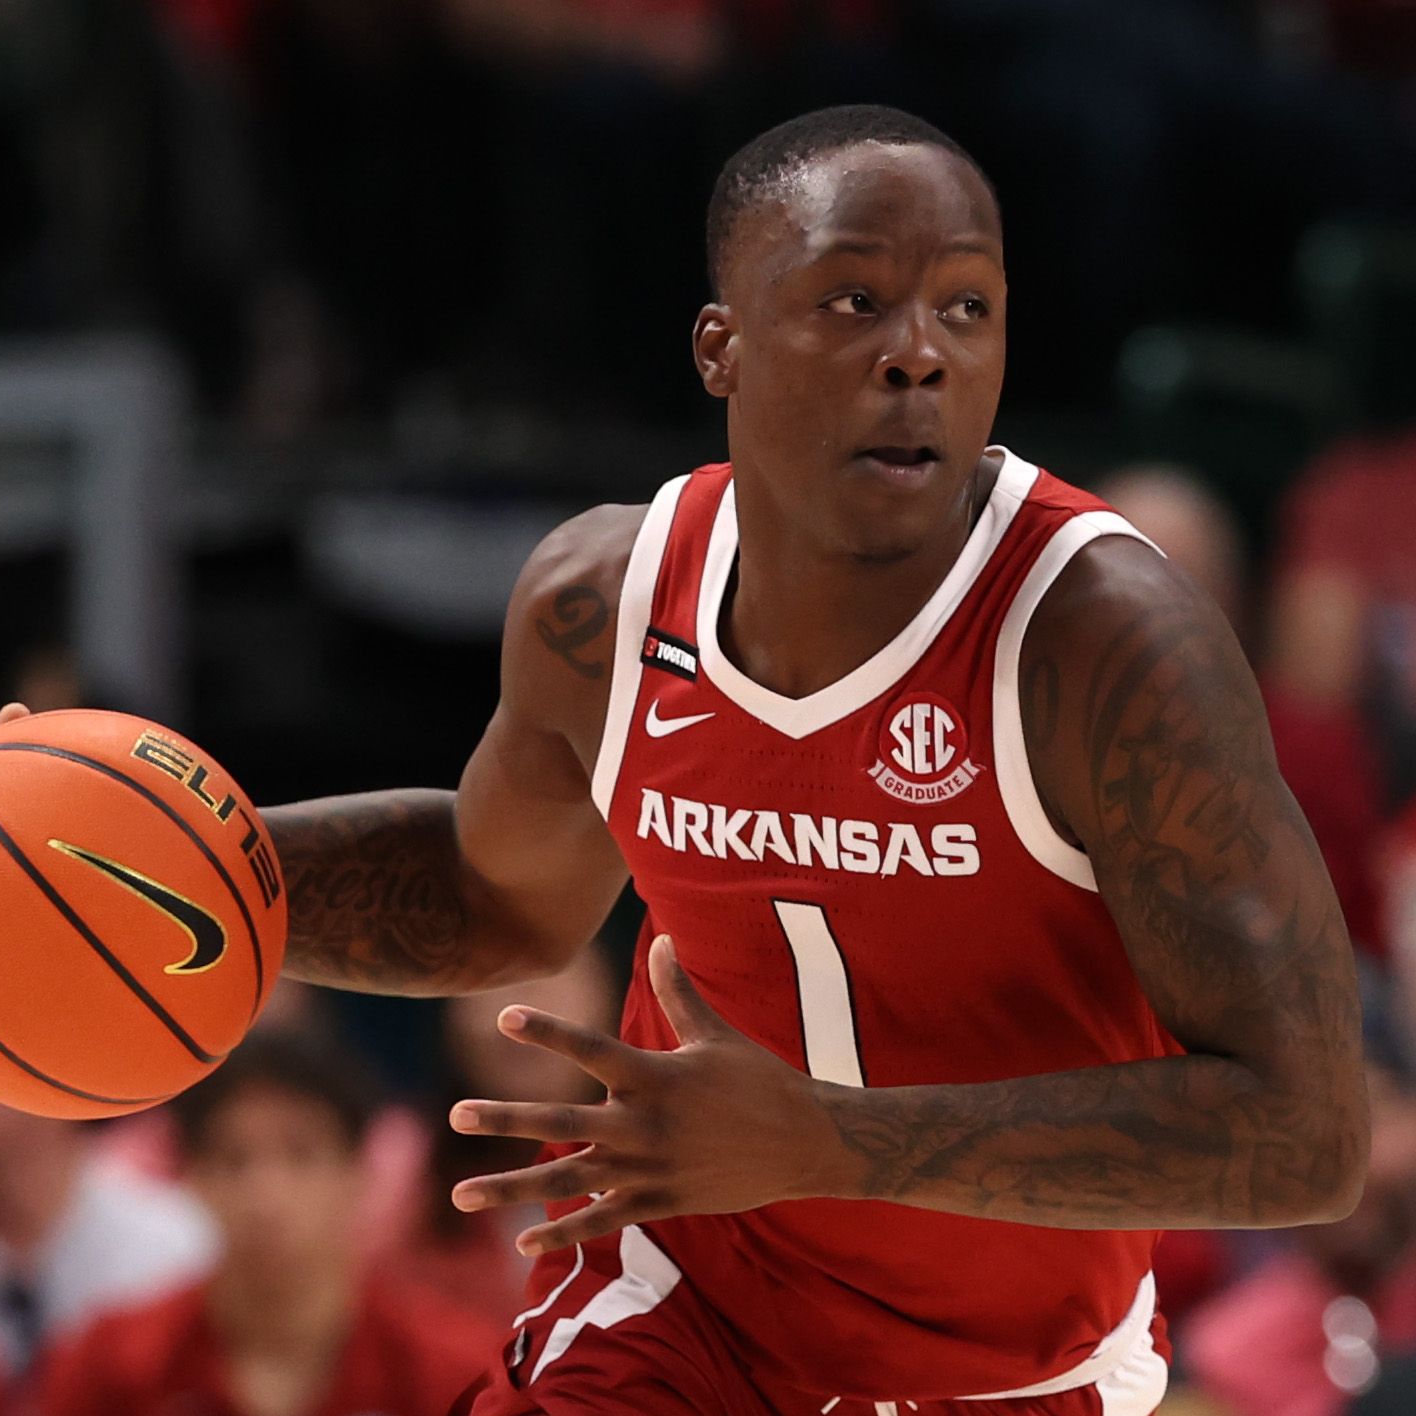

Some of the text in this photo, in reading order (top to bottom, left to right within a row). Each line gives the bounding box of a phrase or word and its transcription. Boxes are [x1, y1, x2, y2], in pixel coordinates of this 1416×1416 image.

[657, 641, 697, 674] TOGET
[888, 702, 957, 775] SEC
[130, 728, 281, 909] ELITE
[883, 775, 965, 801] GRADUATE
[636, 787, 981, 879] ARKANSAS
[771, 897, 868, 1089] 1
